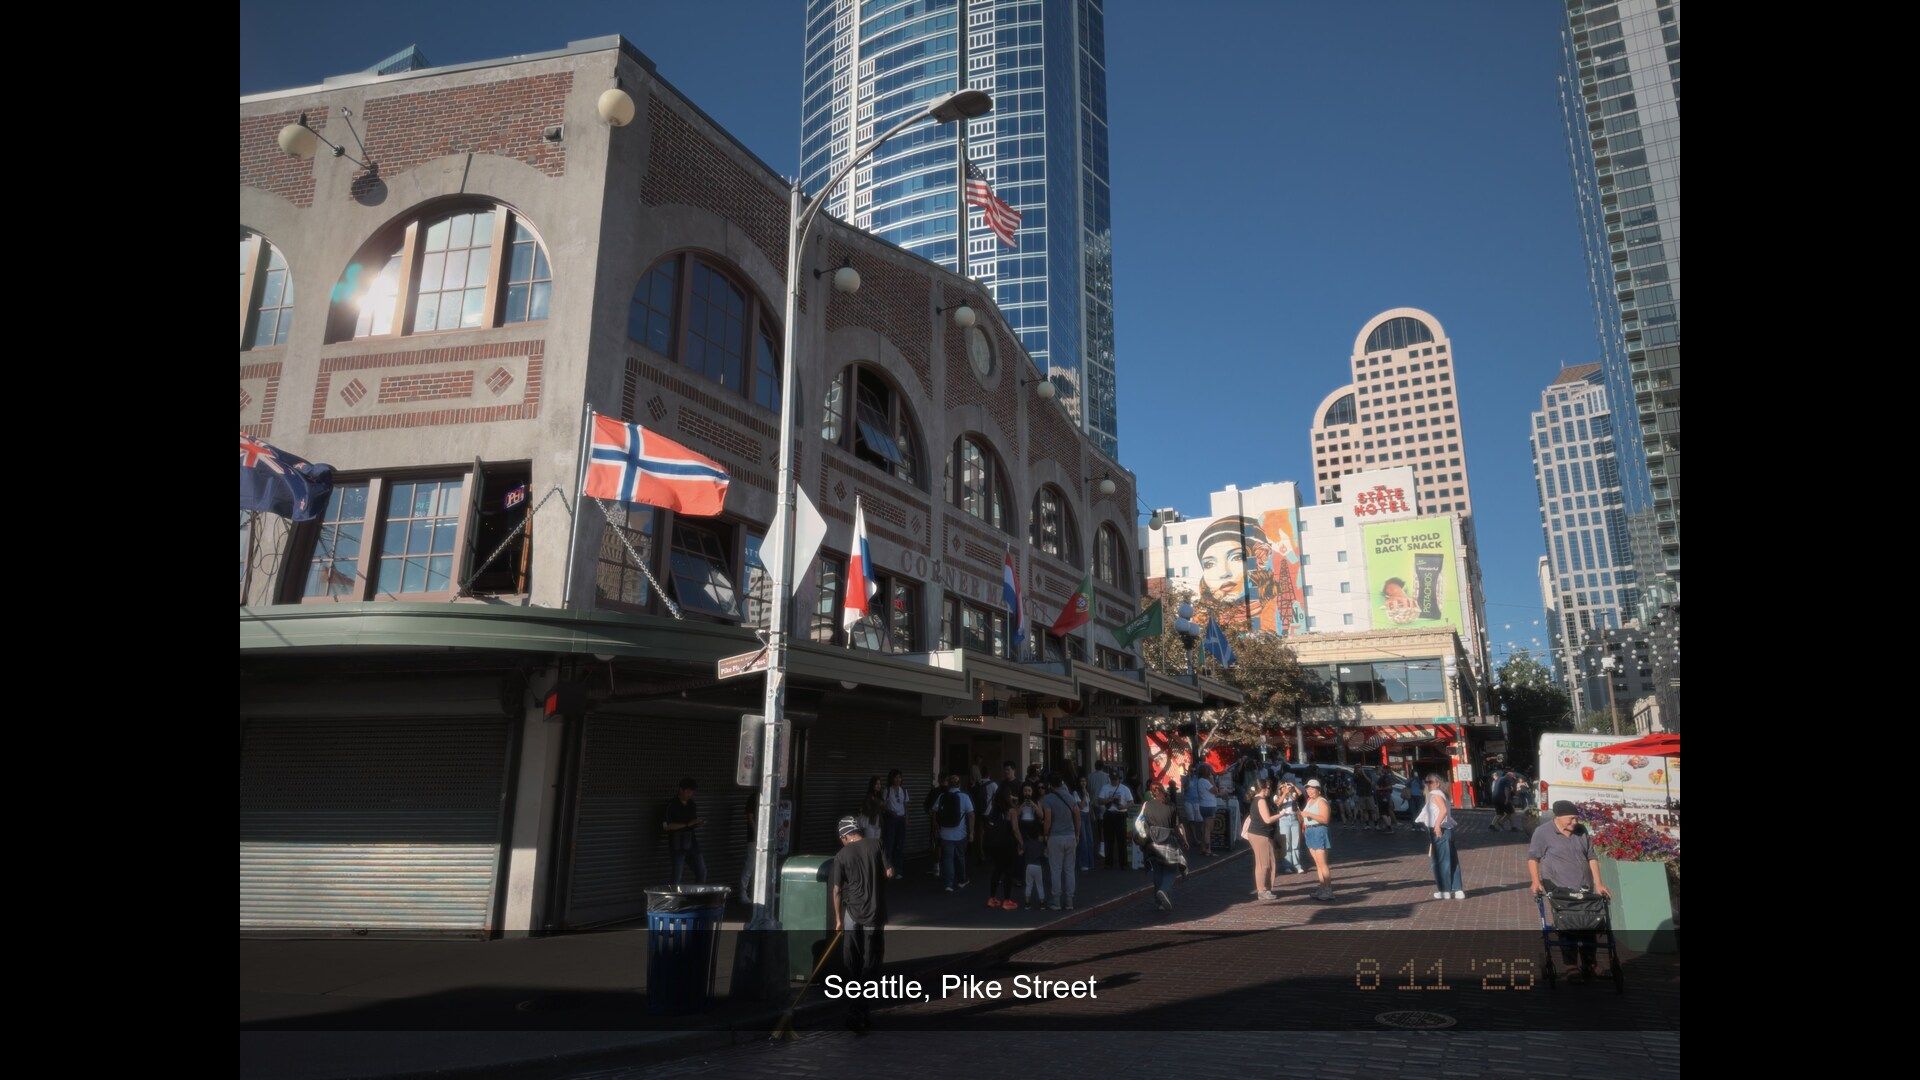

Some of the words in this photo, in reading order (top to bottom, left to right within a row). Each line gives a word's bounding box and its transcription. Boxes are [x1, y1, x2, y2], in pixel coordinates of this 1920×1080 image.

[1357, 487, 1405, 504] STATE
[1354, 500, 1410, 517] HOTEL
[1375, 536, 1408, 546] DON'T
[1411, 532, 1440, 543] HOLD
[1375, 545, 1403, 554] BACK
[1407, 541, 1442, 551] SNACK
[901, 550, 979, 599] CORNER
[1423, 572, 1433, 613] PISTACHIOS
[720, 667, 732, 675] Pike
